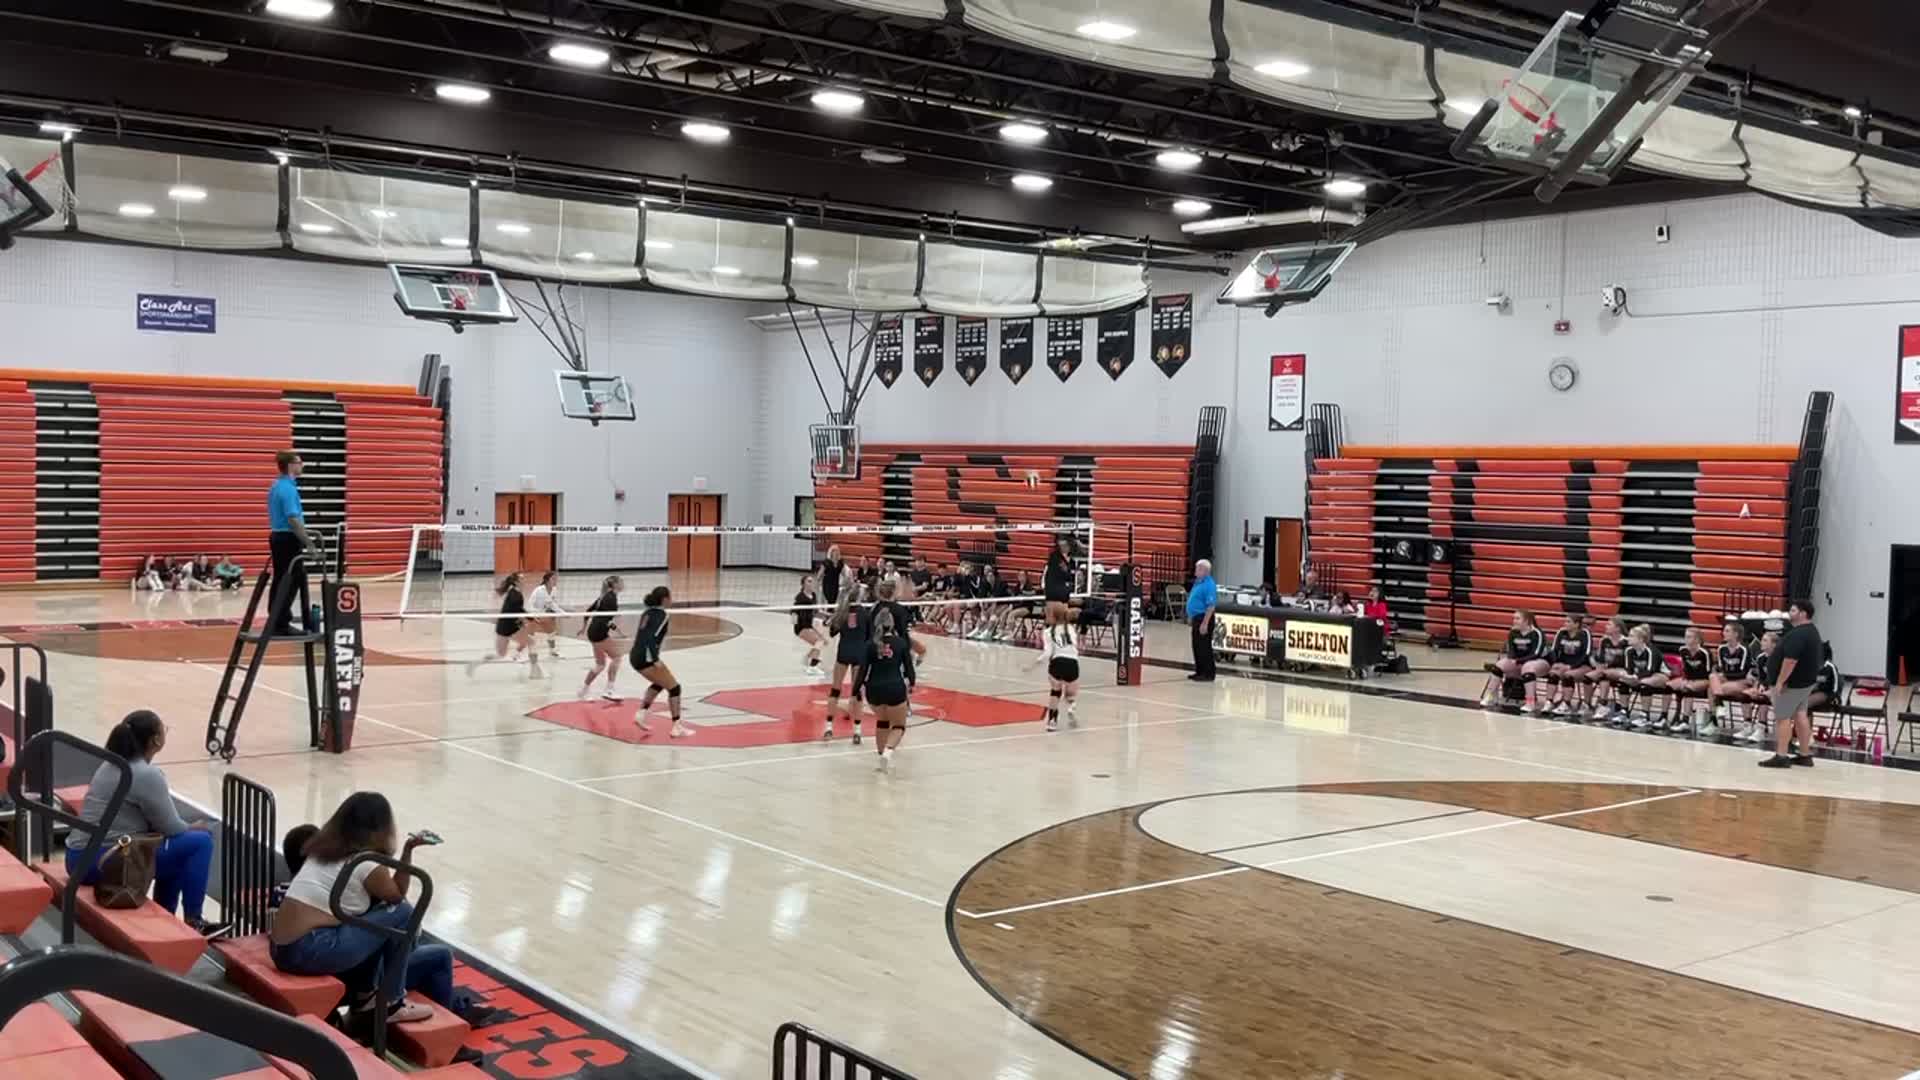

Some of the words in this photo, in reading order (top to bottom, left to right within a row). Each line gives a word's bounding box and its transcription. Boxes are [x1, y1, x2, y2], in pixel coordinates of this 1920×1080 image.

[337, 586, 358, 613] S
[1130, 597, 1141, 658] GAELS
[1231, 623, 1254, 637] GAELS
[1288, 629, 1349, 655] SHELTON
[1313, 654, 1337, 663] SCHOOL
